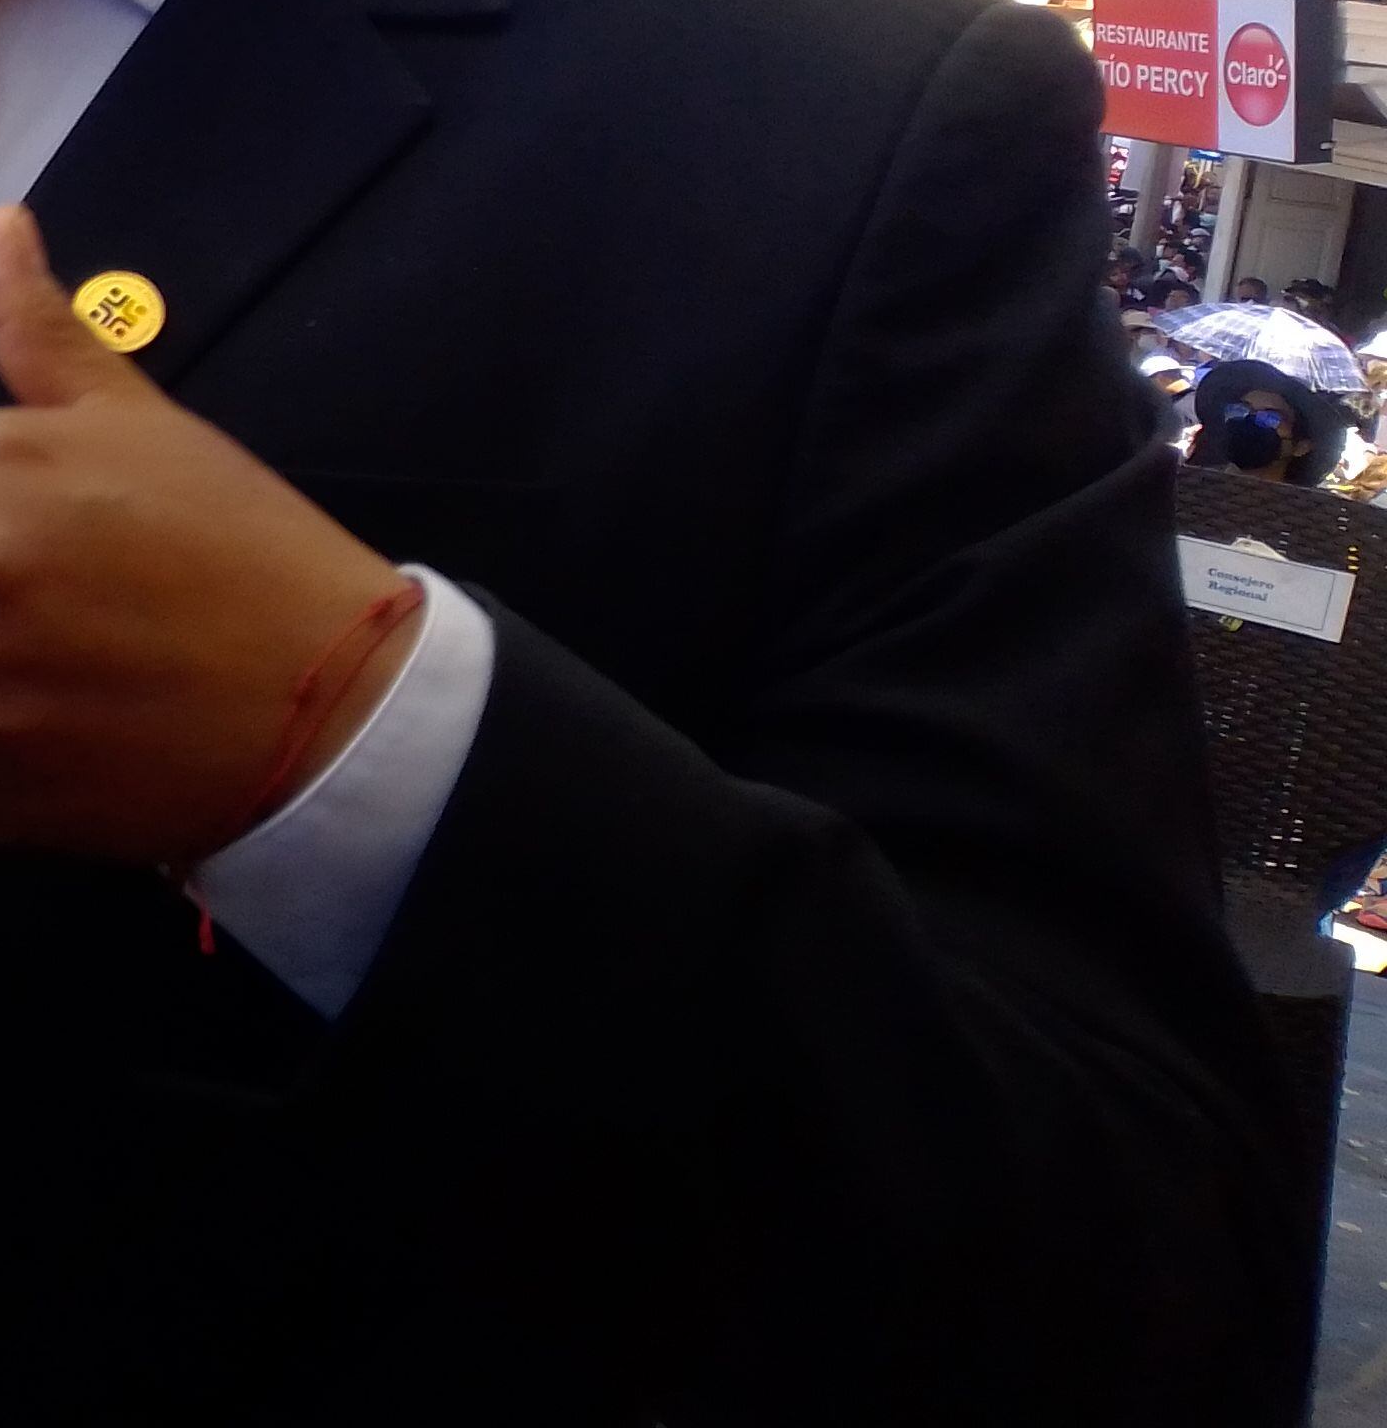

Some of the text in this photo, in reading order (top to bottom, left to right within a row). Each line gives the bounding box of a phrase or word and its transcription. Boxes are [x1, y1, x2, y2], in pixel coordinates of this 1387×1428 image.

[1095, 22, 1209, 54] RESTAURANTE
[1097, 53, 1208, 98] TÍO PERCY
[1227, 60, 1278, 89] Claro
[1208, 567, 1274, 590] Consejero
[1208, 580, 1269, 601] Regional
